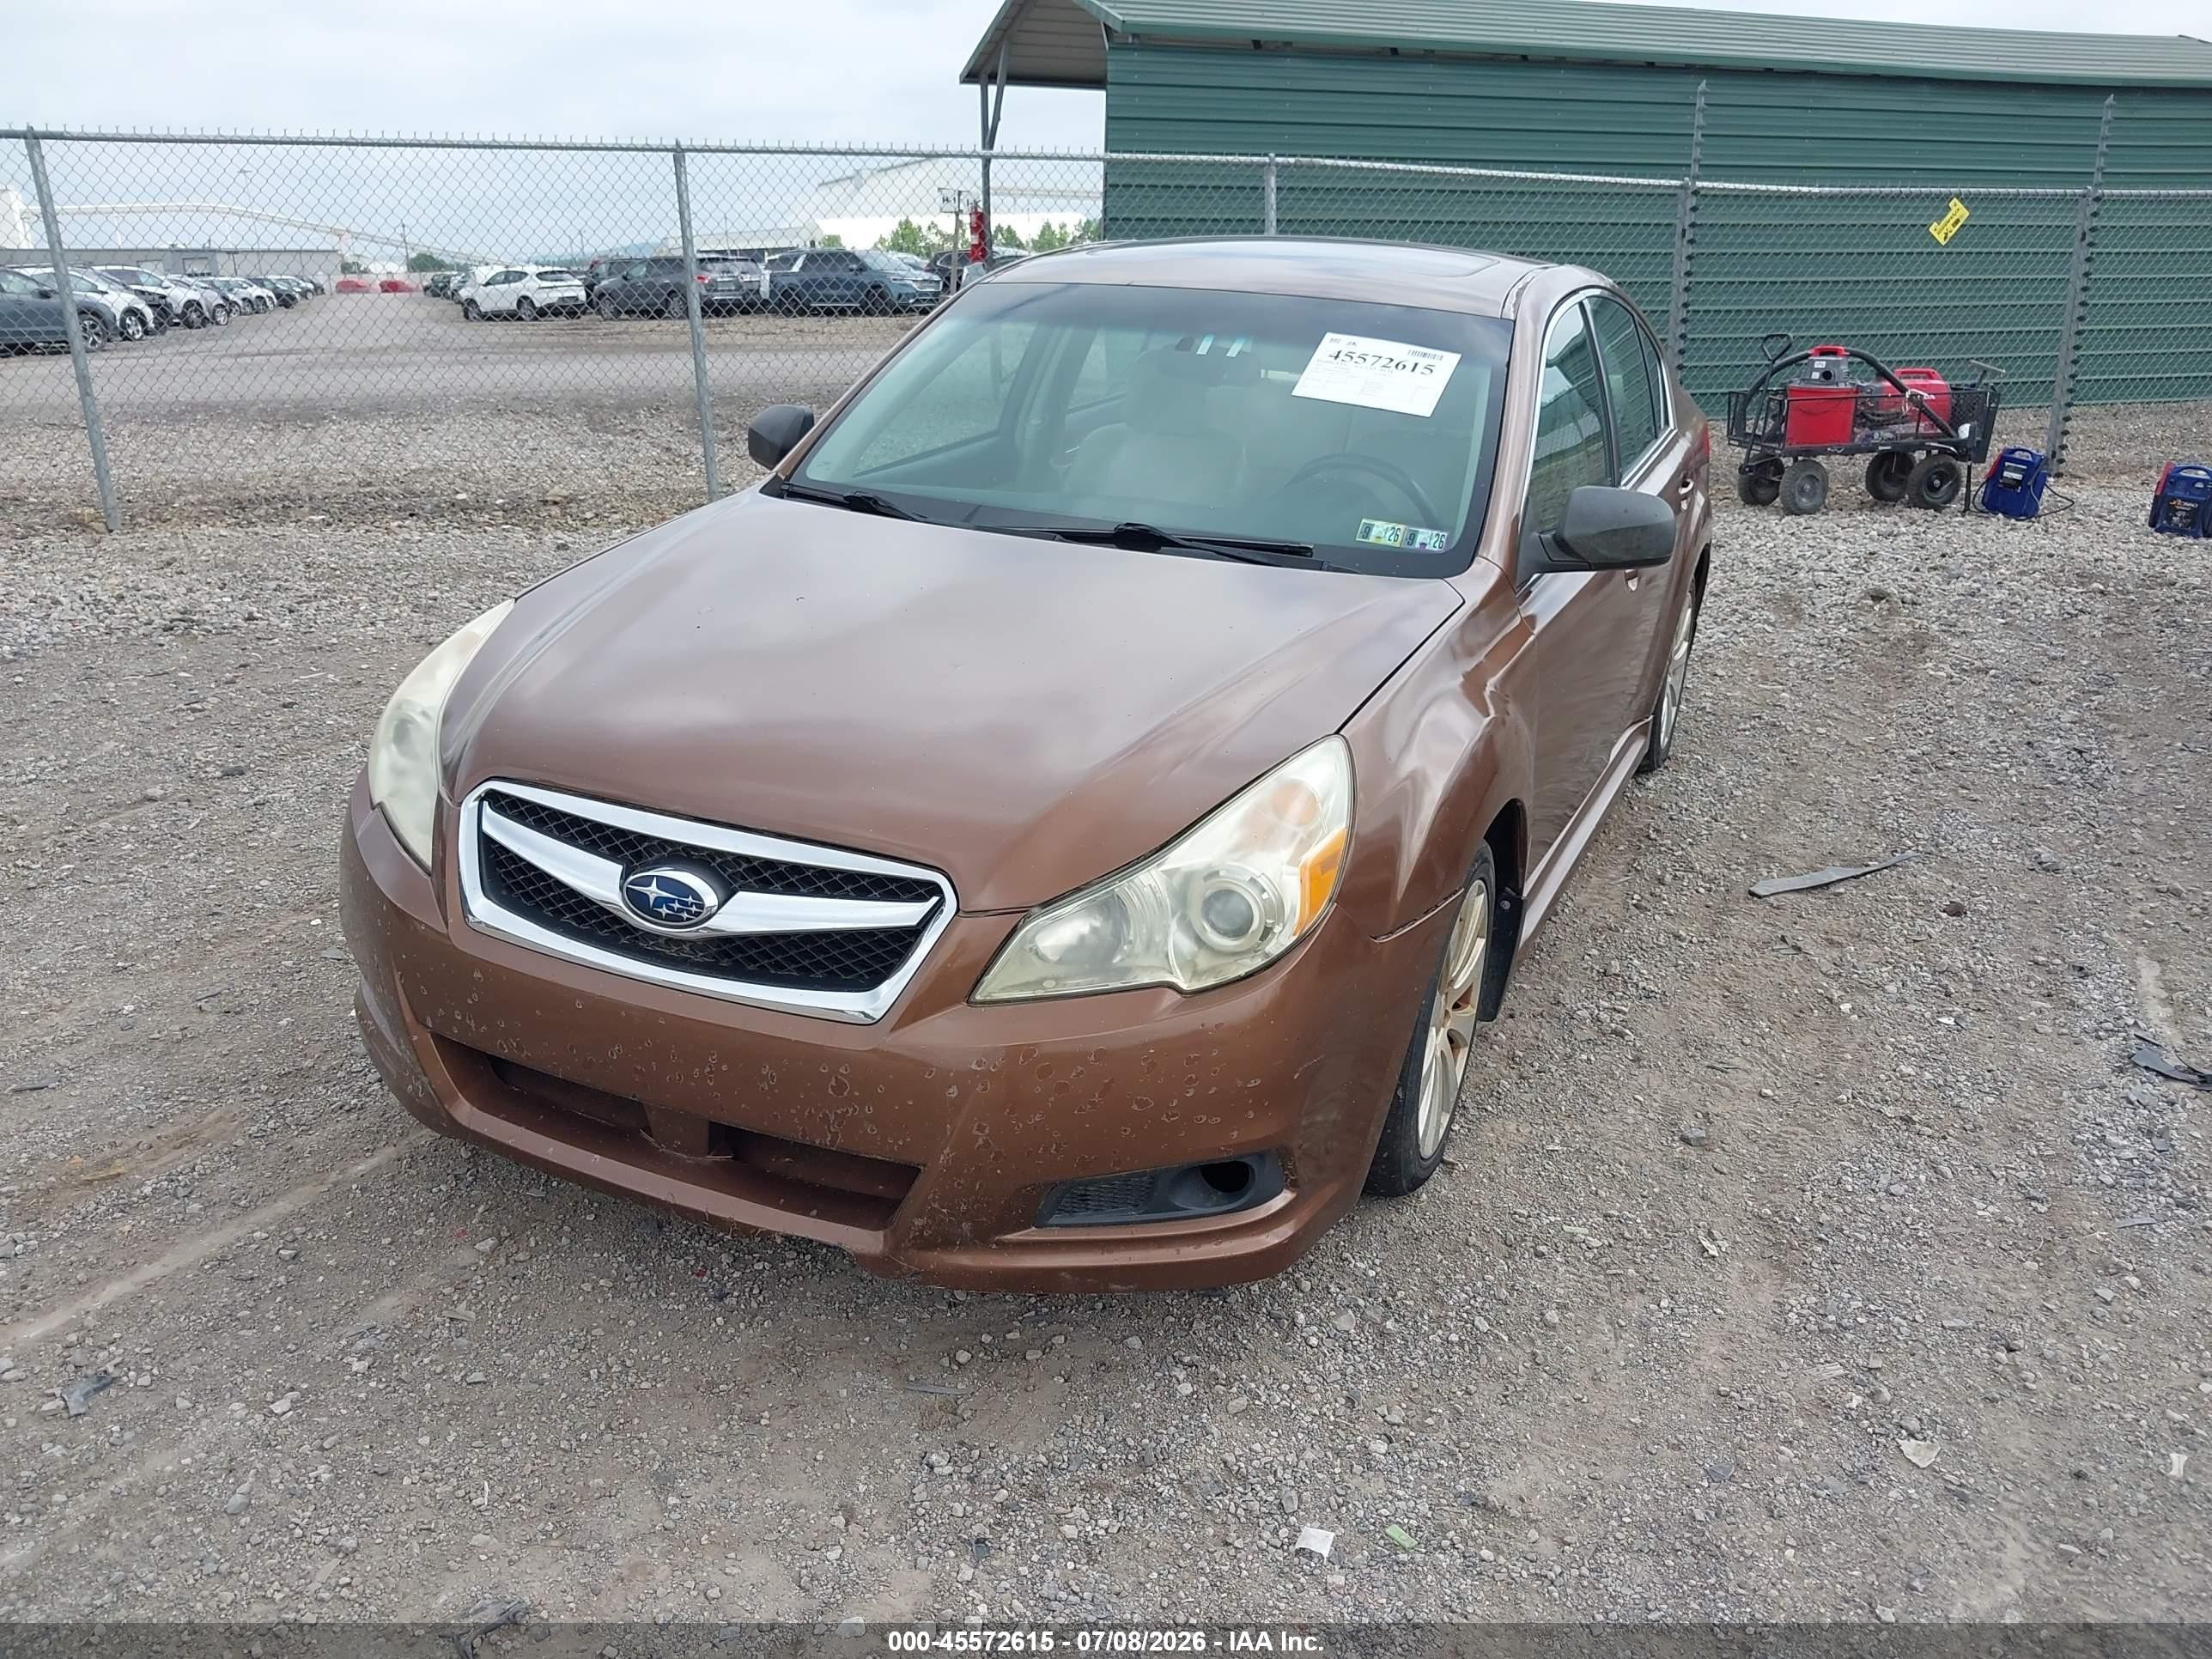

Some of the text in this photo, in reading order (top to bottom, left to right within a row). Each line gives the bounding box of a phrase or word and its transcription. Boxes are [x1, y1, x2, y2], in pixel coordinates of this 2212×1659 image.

[1328, 349, 1437, 376] 45572615
[1388, 526, 1401, 543] 26
[1432, 532, 1446, 550] 26
